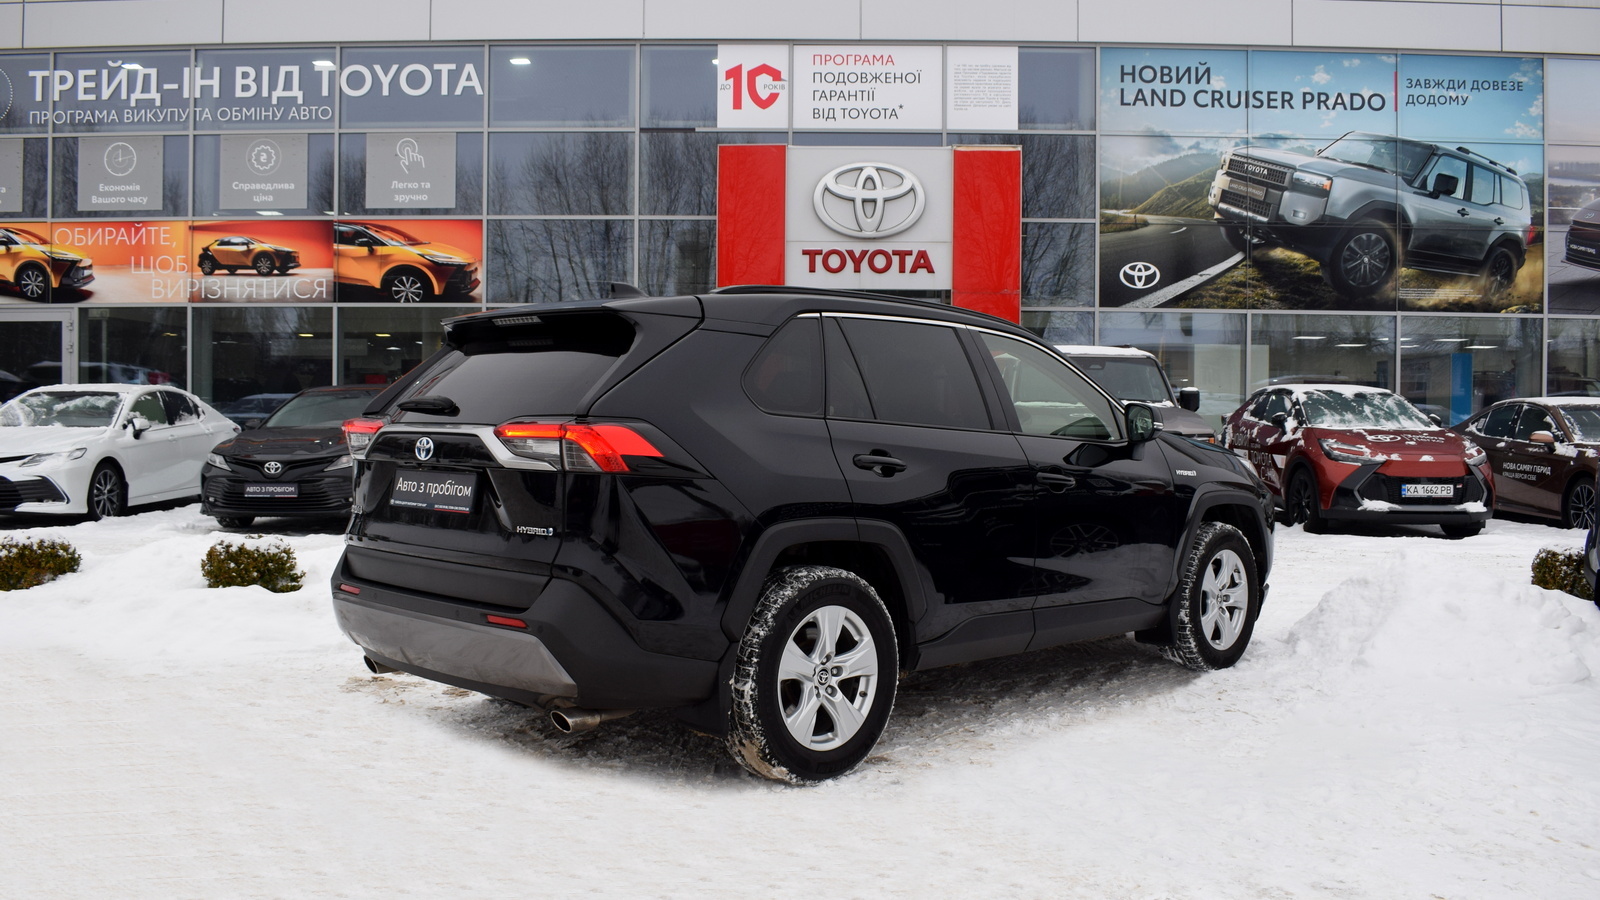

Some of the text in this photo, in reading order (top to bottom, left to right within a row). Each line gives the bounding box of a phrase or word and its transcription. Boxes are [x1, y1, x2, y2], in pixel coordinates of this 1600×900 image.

[813, 54, 895, 66] ПРОГРАМА
[813, 70, 922, 85] ПОДОВЖЕНОЇ
[1120, 62, 1211, 84] НОВИЙ
[28, 60, 484, 106] ТРЕЙД-ІН ВІД TOYOTA
[720, 83, 731, 91] ДО
[1405, 78, 1524, 92] ЗАВЖДИ ДОВЕЗЕ
[813, 87, 876, 102] ГАРАНТІЇ
[1120, 88, 1386, 112] LAND CRUISER PRADO
[1405, 94, 1469, 107] ДОДОМУ
[29, 105, 332, 125] ПРОГРАМА ВИКУПУ ТА ОБМІНУ АВТО
[813, 108, 836, 121] ВІД
[1244, 164, 1268, 175] TOYOTA
[98, 183, 141, 192] Економія
[232, 181, 295, 191] Справедлива
[391, 181, 419, 189] Легко
[91, 195, 148, 205] Вашого часу
[253, 193, 274, 203] ціна
[394, 194, 428, 203] зручно
[54, 222, 177, 249] ОБИРАЙТЕ,
[130, 255, 189, 275] ЩОБ
[802, 249, 935, 273] TOYOTA
[151, 278, 327, 301] ВИРІЗНЯТИСЯ
[1502, 462, 1516, 470] НОВА
[1516, 463, 1533, 471] CAMRY
[396, 477, 472, 497] Авто з пробігом
[1421, 486, 1439, 495] 1662
[516, 525, 548, 535] HYBRID
